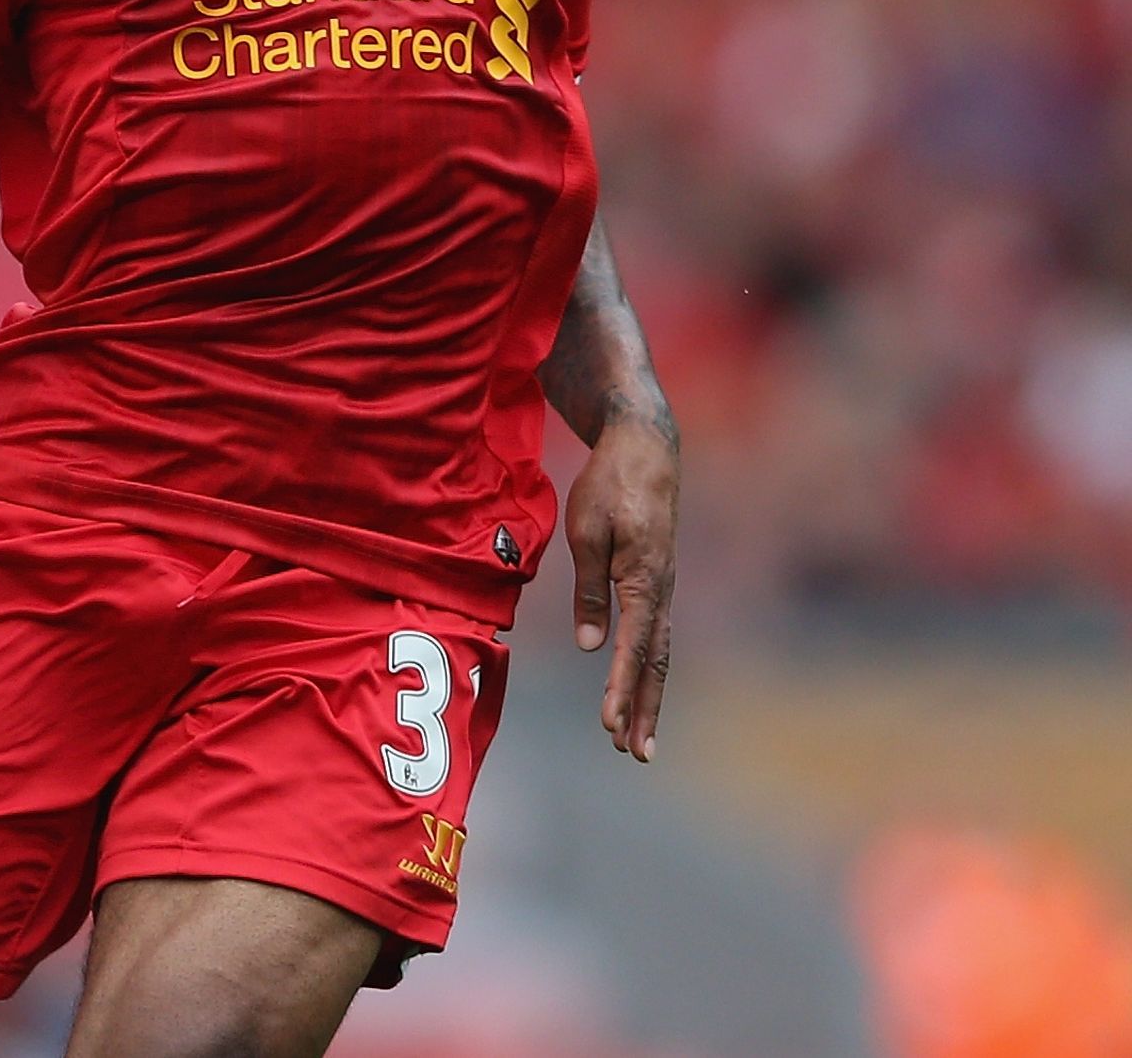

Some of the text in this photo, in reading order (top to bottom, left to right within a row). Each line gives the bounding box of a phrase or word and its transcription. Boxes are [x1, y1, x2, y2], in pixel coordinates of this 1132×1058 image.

[173, 18, 476, 80] Chartered
[381, 630, 481, 798] 3
[398, 858, 458, 893] WARRIO
